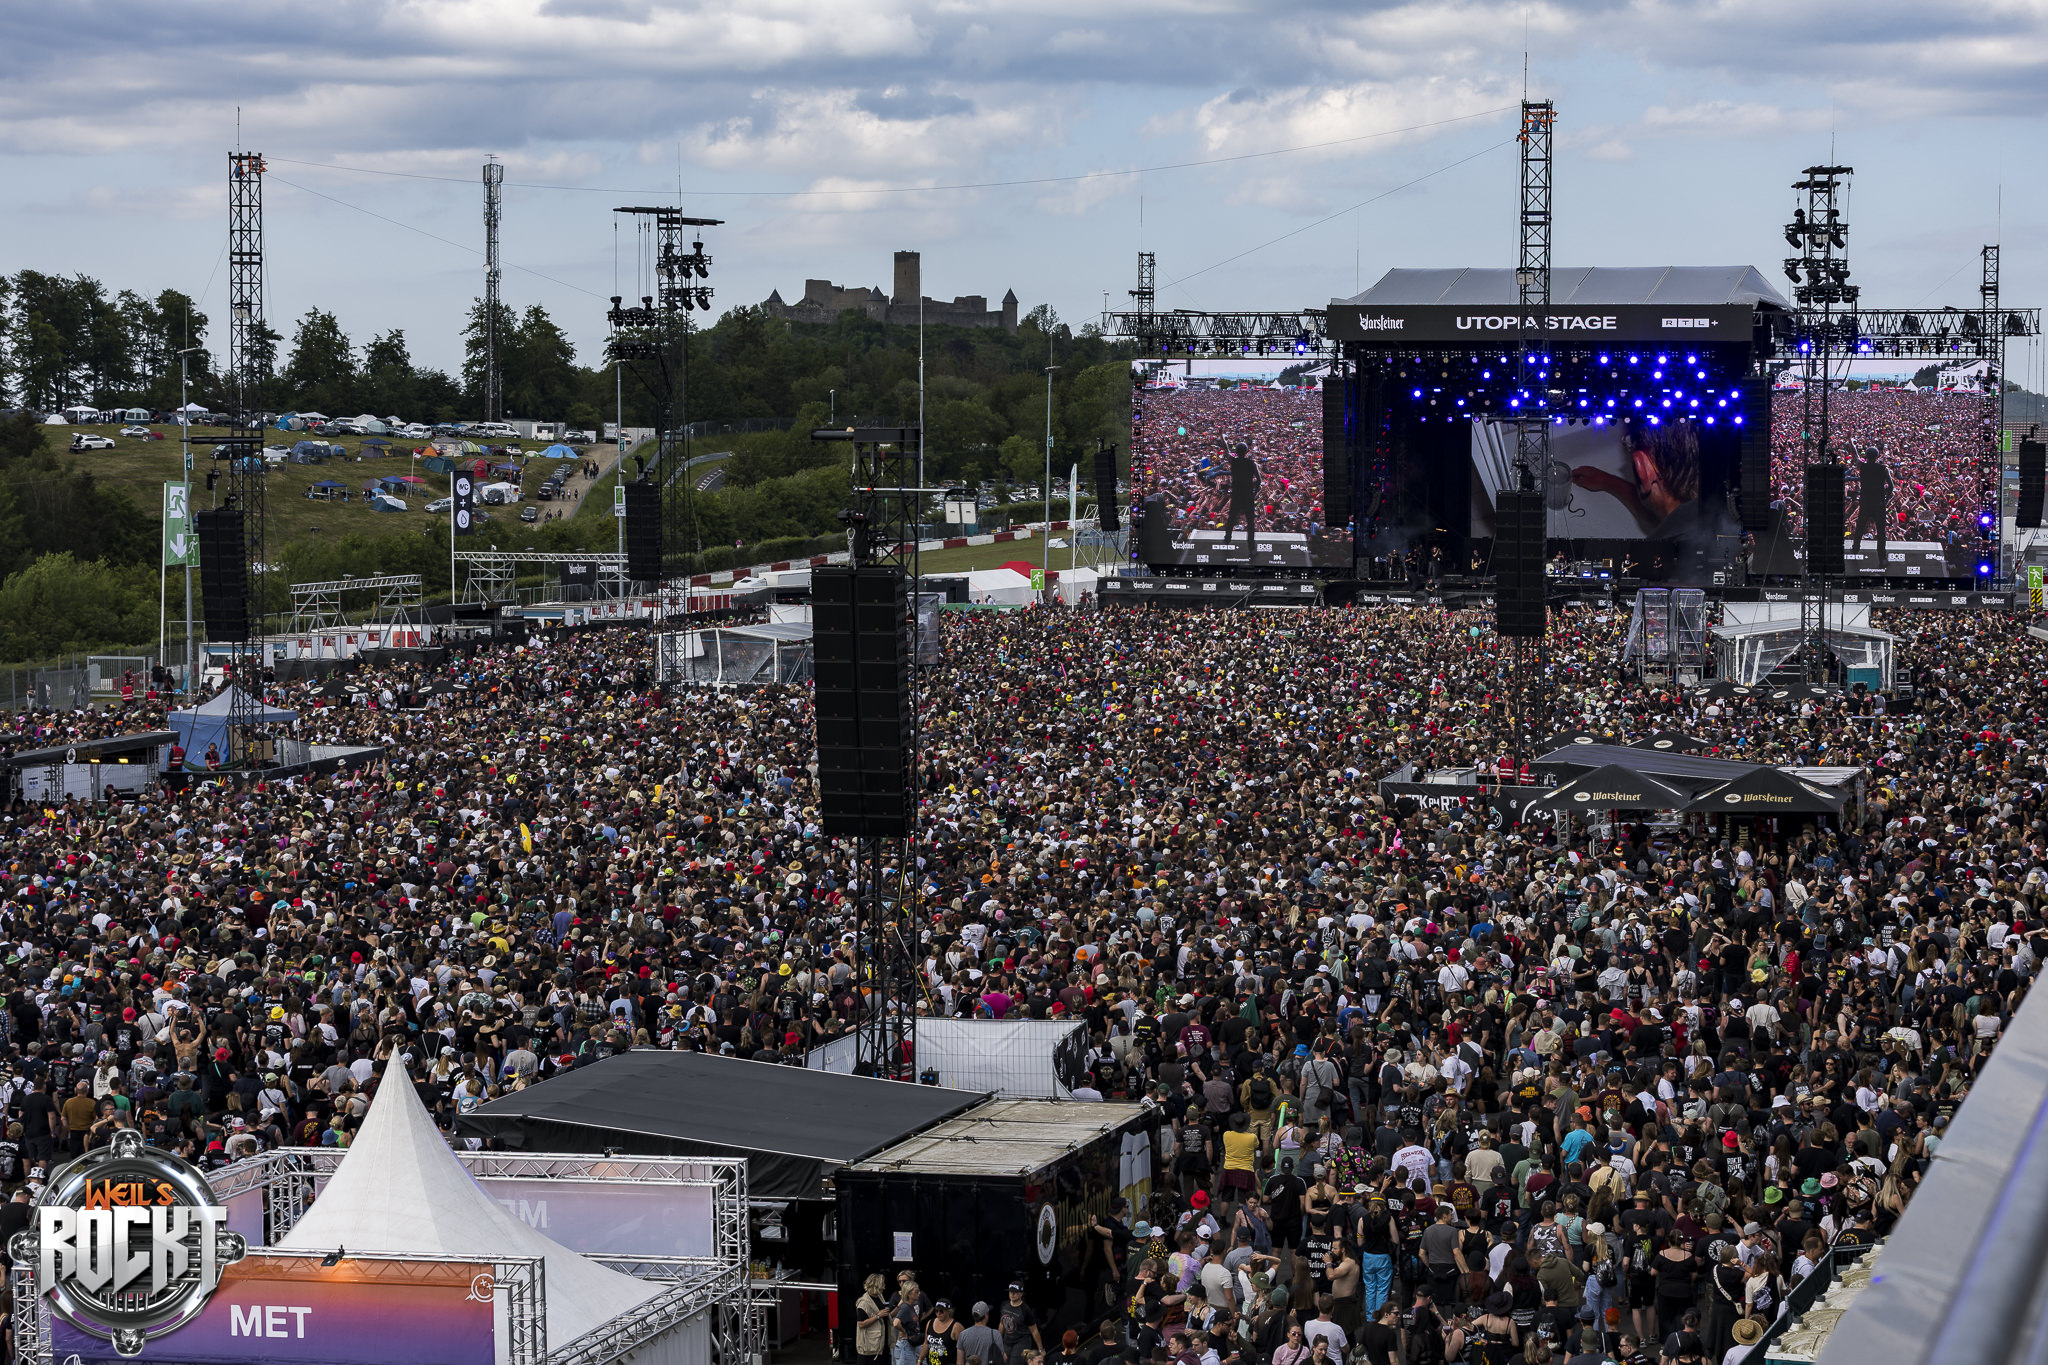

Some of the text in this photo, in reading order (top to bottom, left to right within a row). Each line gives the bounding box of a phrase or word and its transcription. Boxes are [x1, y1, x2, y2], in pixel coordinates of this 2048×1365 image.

[1456, 316, 1617, 330] UTOPIA STAGE
[1661, 318, 1719, 328] RTL+
[1592, 791, 1642, 801] Warsteiner
[1743, 793, 1794, 803] Warsteiner
[230, 1305, 312, 1339] MET
